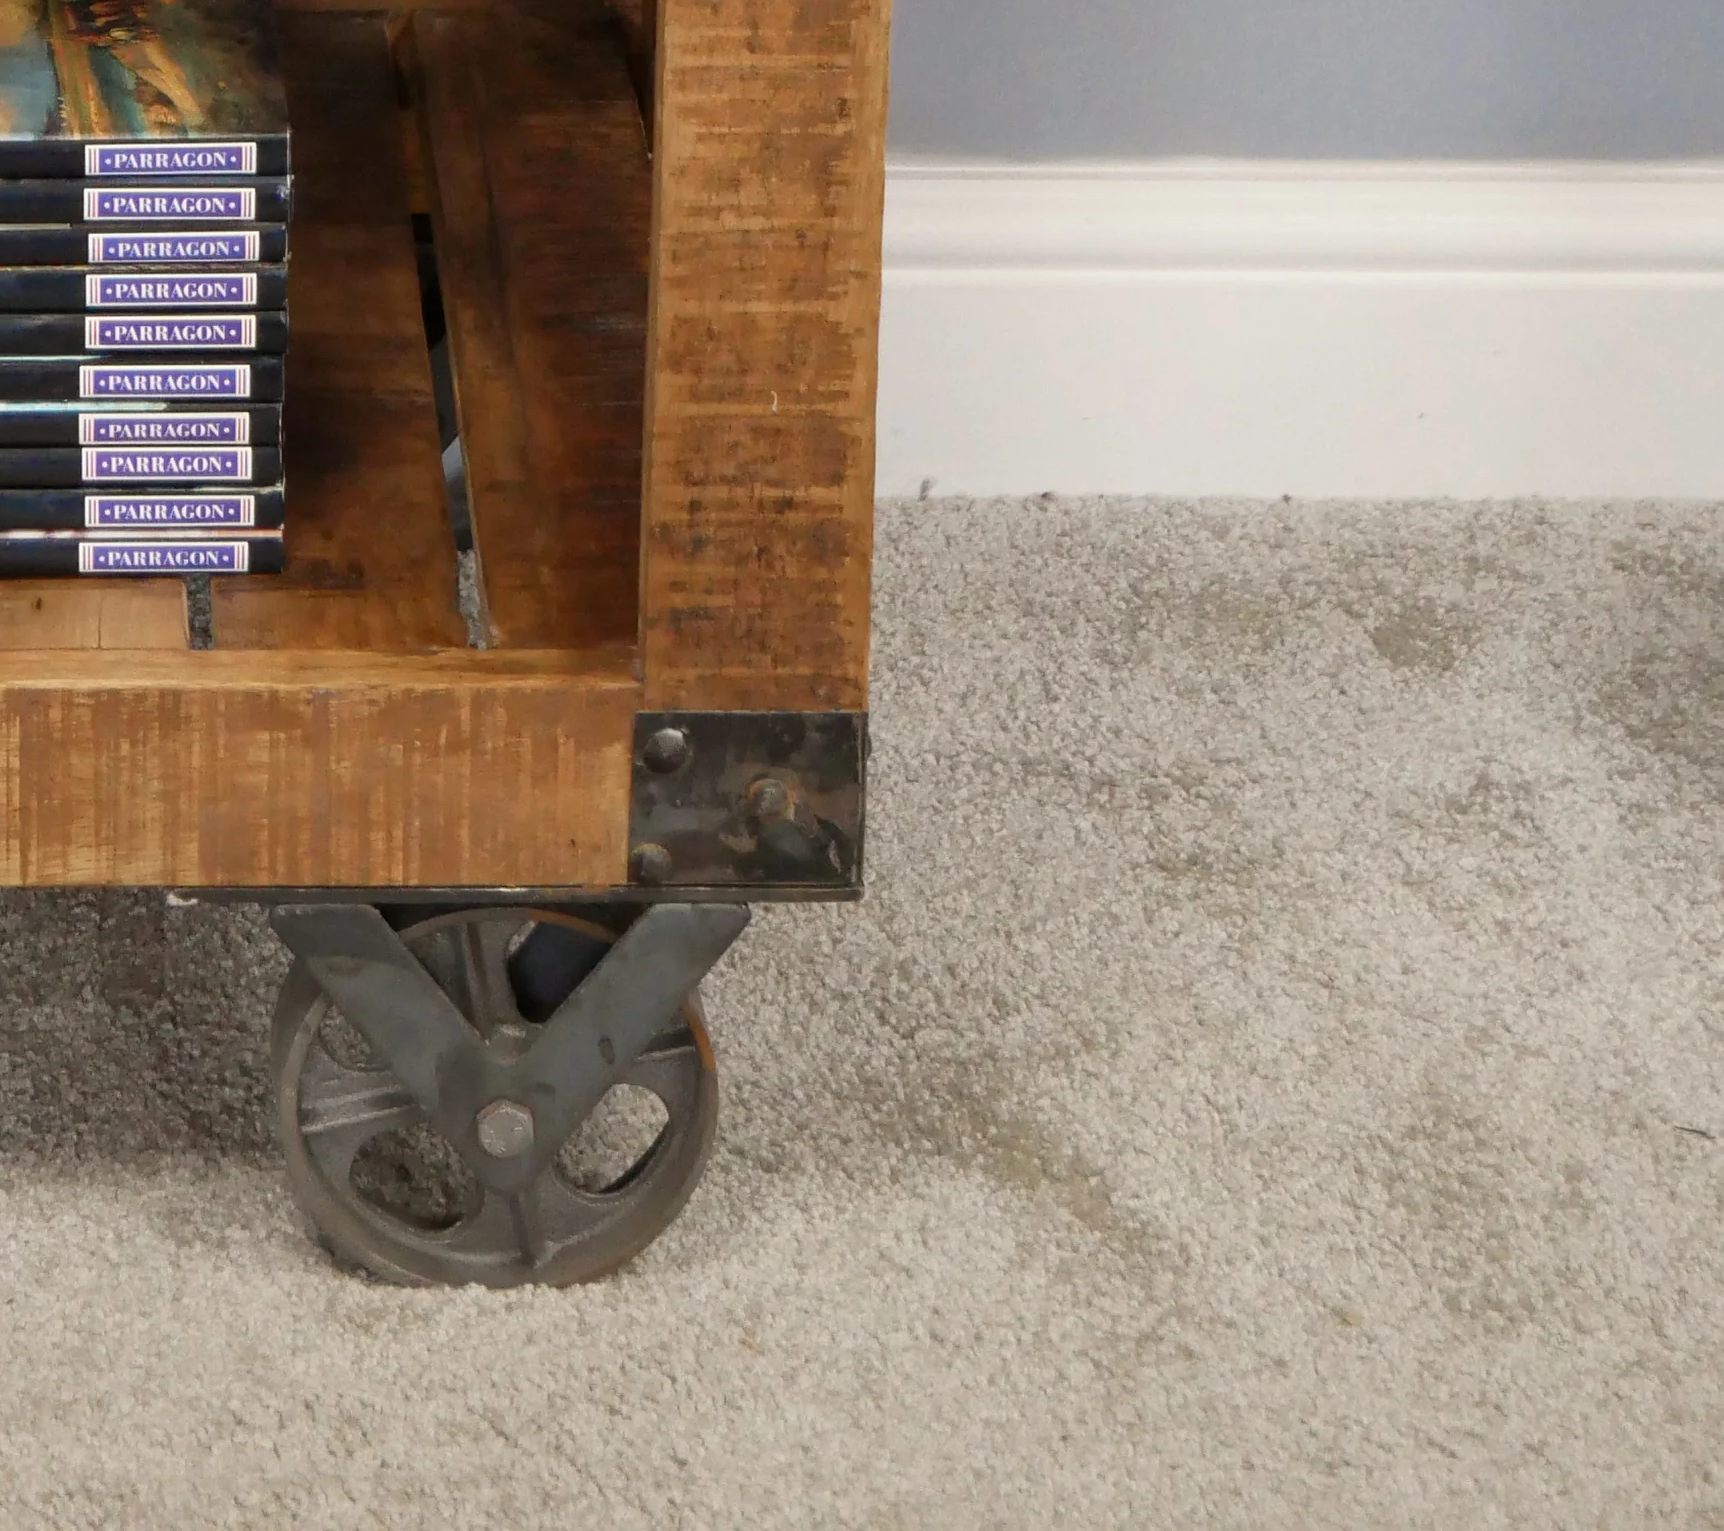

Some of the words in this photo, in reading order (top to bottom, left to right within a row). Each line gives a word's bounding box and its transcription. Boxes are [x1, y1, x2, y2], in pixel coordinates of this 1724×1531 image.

[114, 152, 226, 169] PARRAGON
[112, 197, 225, 213] PARRAGON
[118, 241, 229, 257] PARRAGON
[115, 283, 227, 299] PARRAGON
[114, 325, 226, 341] PARRAGON
[108, 375, 219, 390] PARRAGON
[108, 423, 220, 438] PARRAGON
[111, 456, 221, 473] PARRAGON
[113, 504, 224, 519] PARRAGON
[107, 551, 218, 566] PARRAGON
